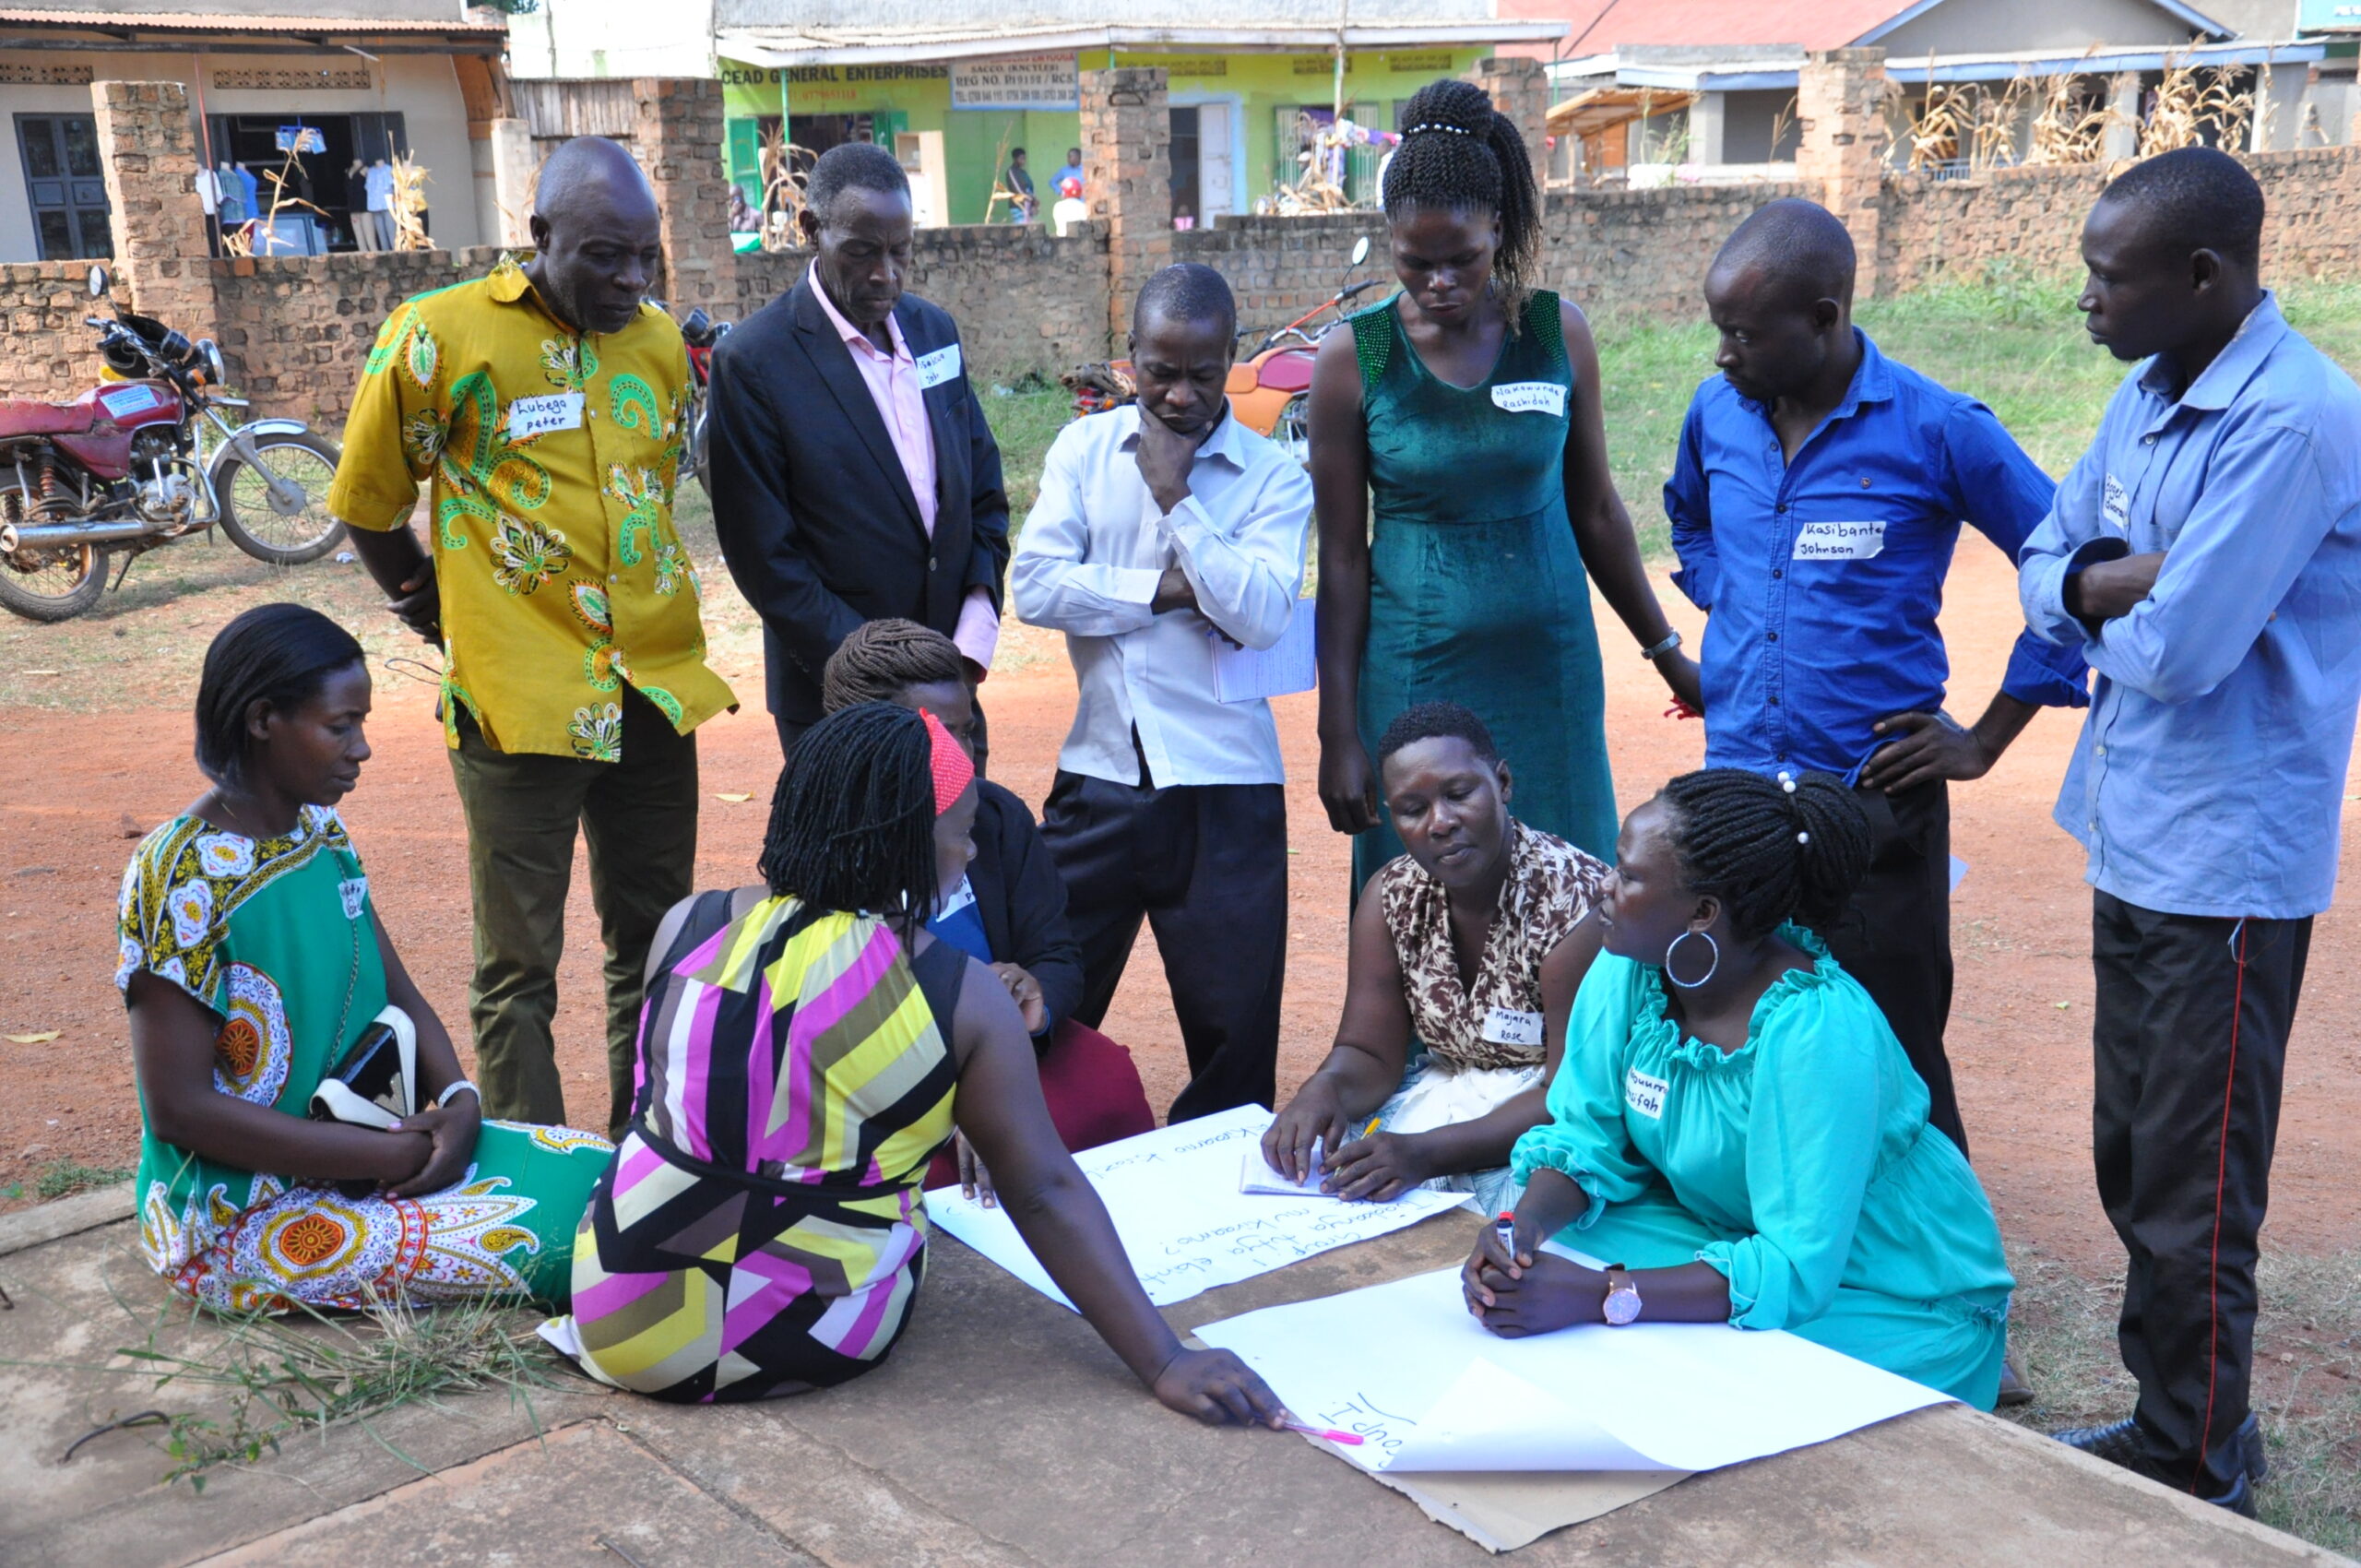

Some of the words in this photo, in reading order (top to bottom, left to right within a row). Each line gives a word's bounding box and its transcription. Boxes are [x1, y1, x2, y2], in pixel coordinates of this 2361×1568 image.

[846, 64, 948, 82] ENTERPRISES
[955, 75, 979, 87] REG
[516, 399, 566, 414] Lubega
[1806, 522, 1882, 538] Kasibante
[1800, 542, 1854, 555] Johnson
[1501, 1029, 1525, 1042] Rose
